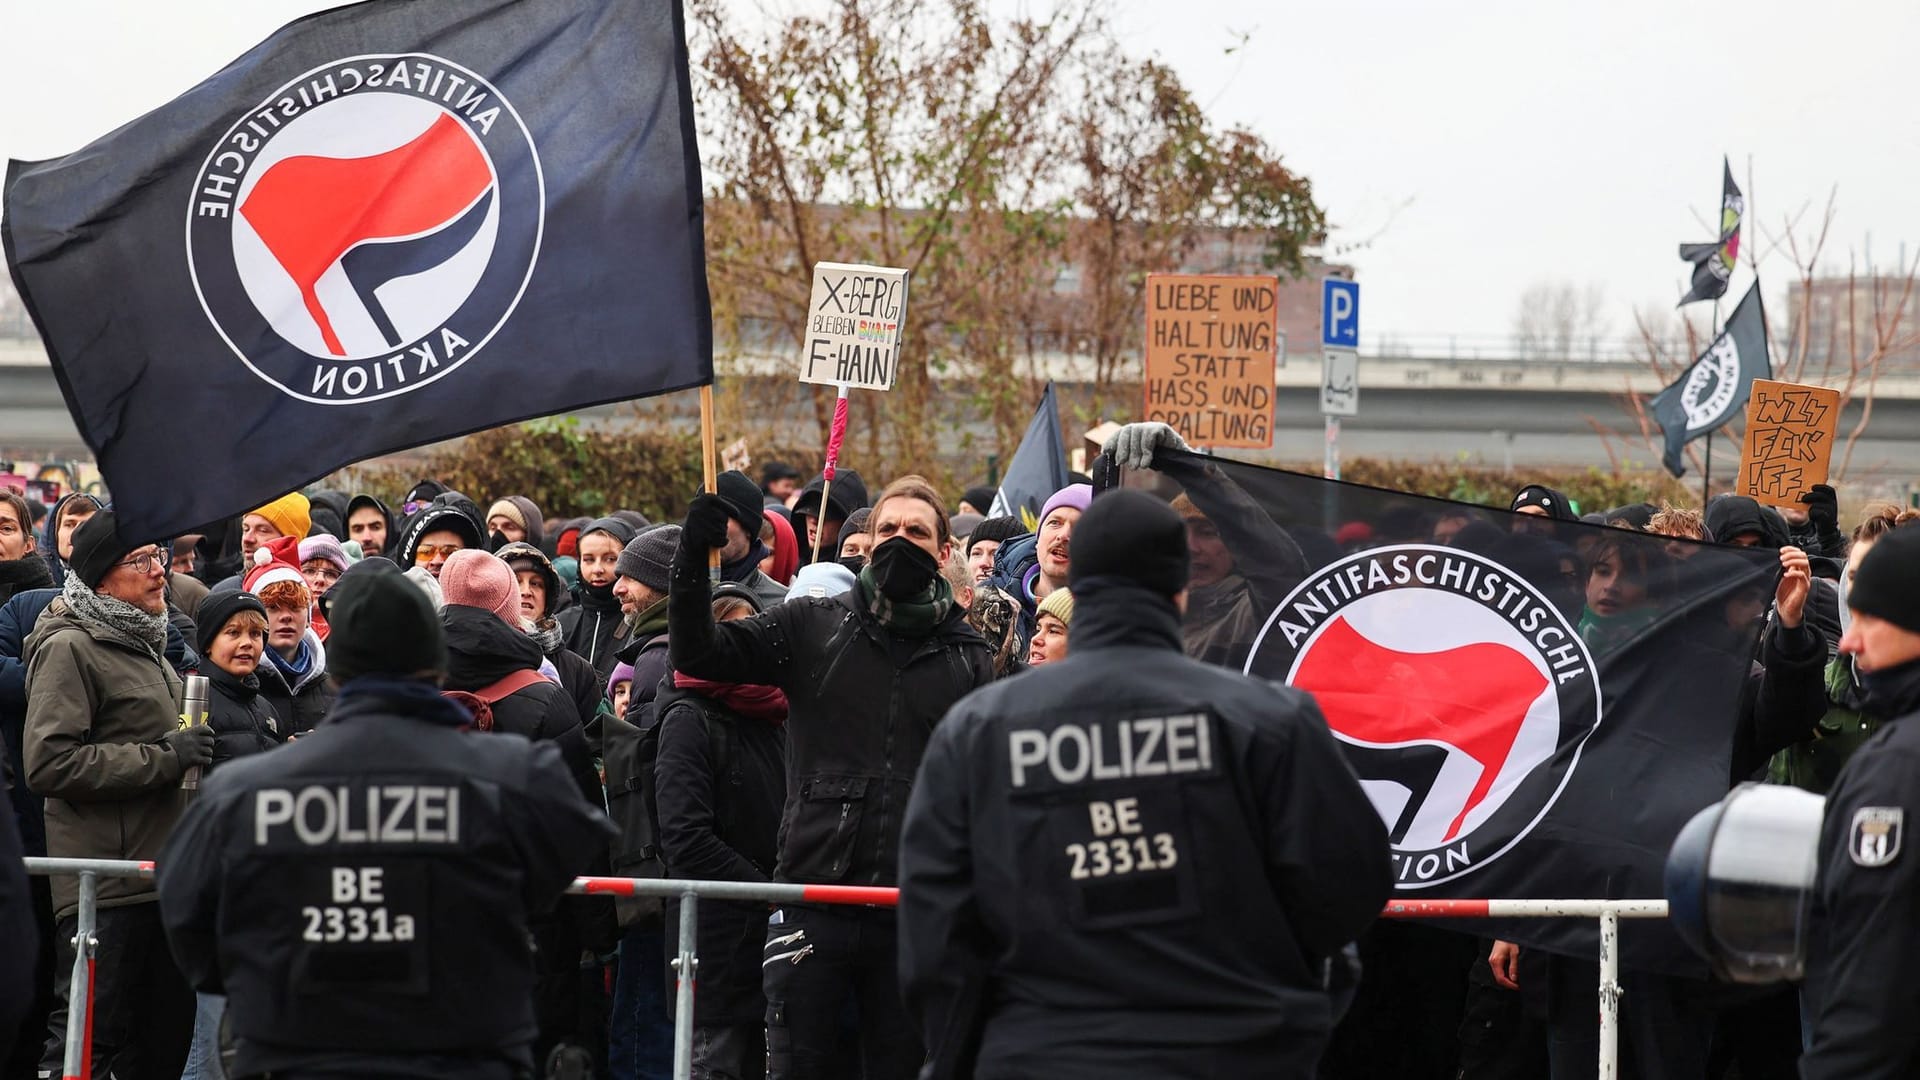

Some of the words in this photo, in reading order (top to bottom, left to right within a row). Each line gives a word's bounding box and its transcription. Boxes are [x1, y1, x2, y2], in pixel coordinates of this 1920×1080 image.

[819, 276, 901, 320] X-BERG
[1156, 284, 1221, 312] LIEBE
[1233, 287, 1275, 313] UND
[1330, 288, 1353, 339] P
[812, 315, 857, 336] BLEIBEN
[858, 319, 897, 344] BUNT
[1154, 320, 1271, 352] HALTUNG
[808, 339, 890, 386] F-HAIN
[1173, 353, 1252, 378] STATT
[1149, 379, 1209, 408] HASS
[1222, 384, 1269, 411] UND
[1009, 713, 1212, 787] POLIZEI
[255, 785, 460, 845] POLIZEI
[1088, 797, 1142, 836] BE
[1065, 832, 1178, 880] 23313
[332, 867, 384, 903] BE
[302, 906, 415, 942] 2331a
